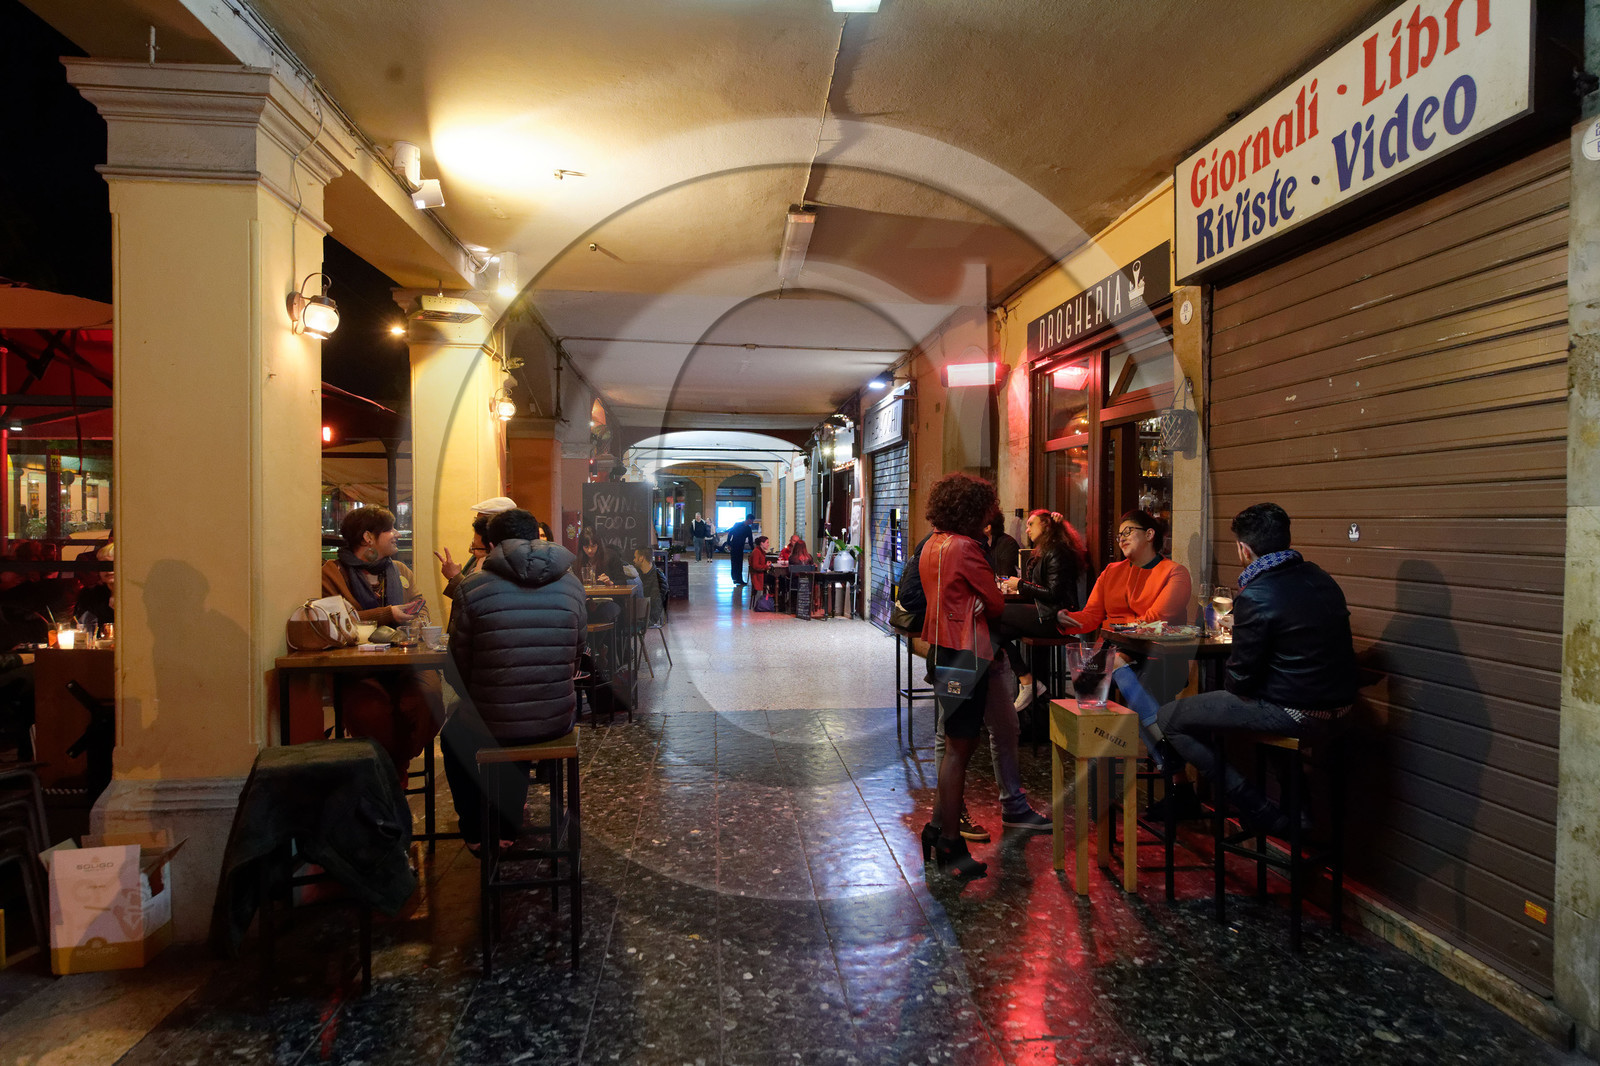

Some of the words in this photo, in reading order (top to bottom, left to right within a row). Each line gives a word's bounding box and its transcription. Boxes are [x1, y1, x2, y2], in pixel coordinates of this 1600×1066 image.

[1190, 78, 1320, 208] Giornali
[1196, 168, 1298, 264] Riviste
[1331, 74, 1478, 192] Video
[1039, 274, 1122, 352] DROGHERIA
[595, 515, 637, 531] FOOD
[1093, 727, 1127, 748] FRAGILE
